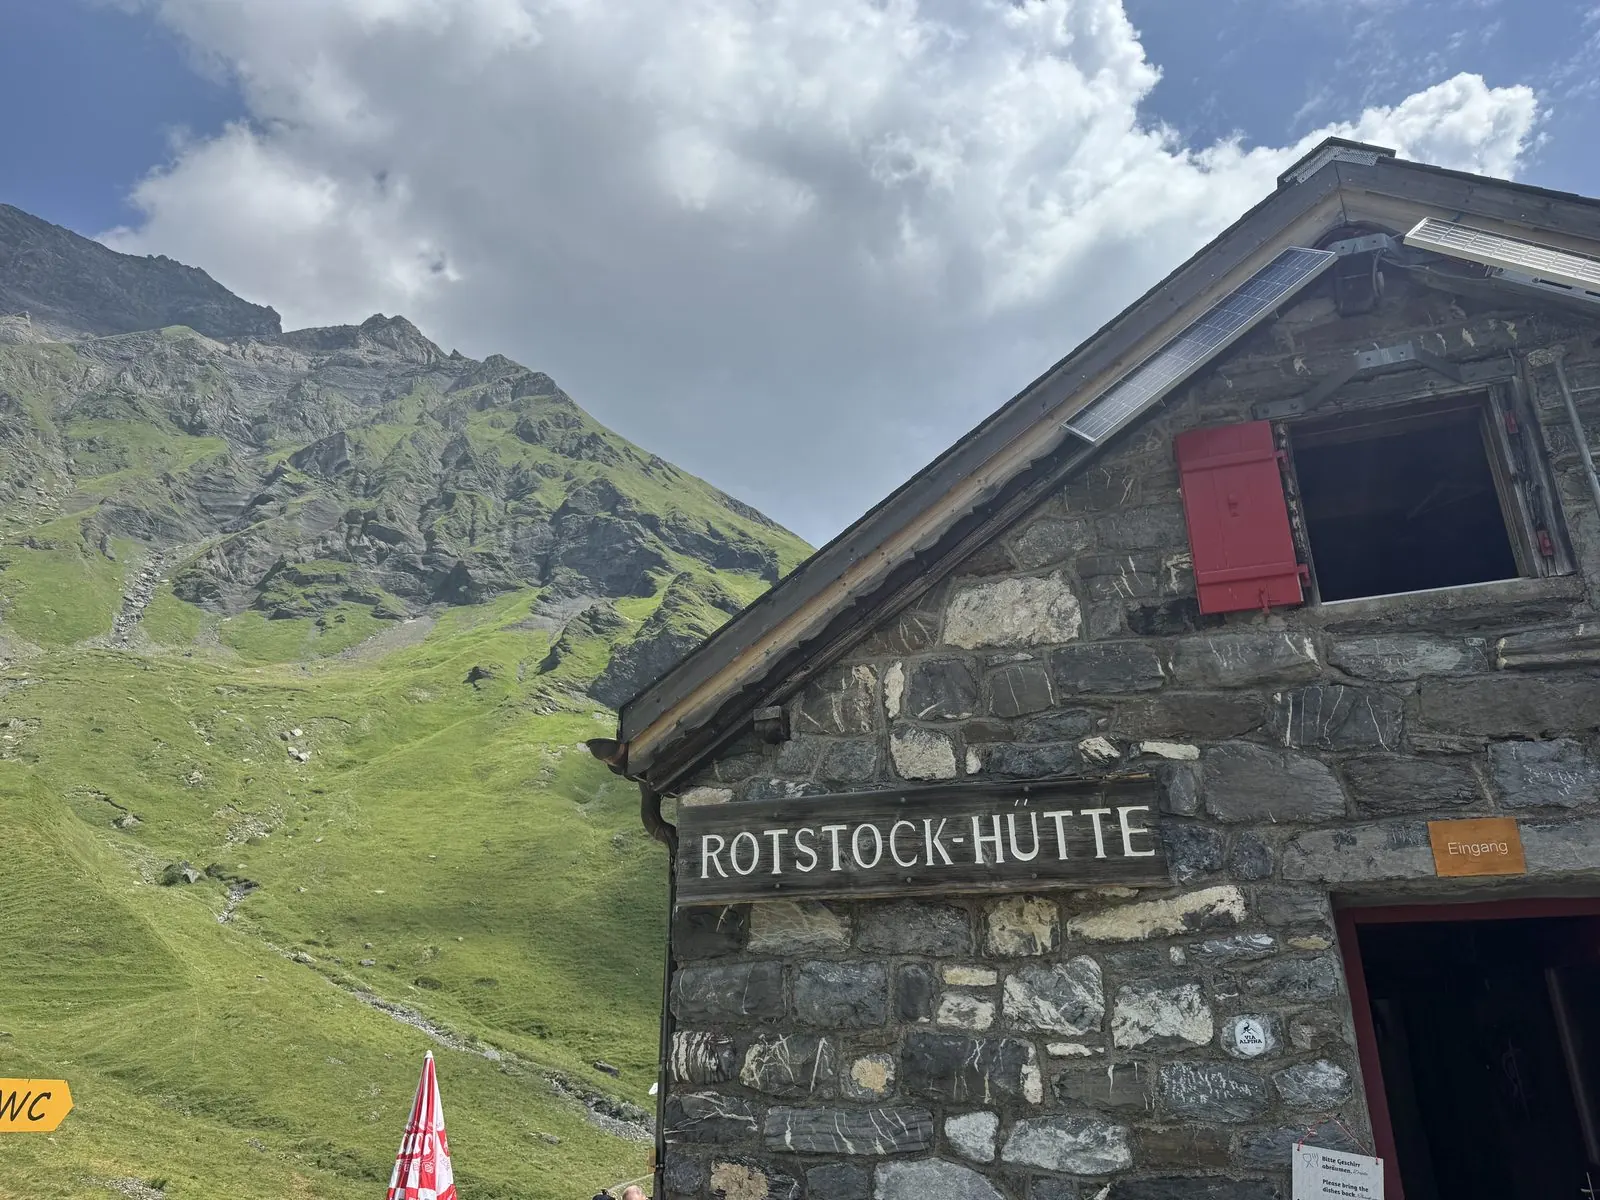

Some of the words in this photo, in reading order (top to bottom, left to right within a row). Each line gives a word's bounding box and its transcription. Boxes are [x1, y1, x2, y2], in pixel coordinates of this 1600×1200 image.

[700, 798, 1156, 879] ROTSTOCK-HÜTTE
[1447, 842, 1508, 857] Eingang
[0, 1090, 52, 1122] WC
[1337, 1158, 1361, 1168] Geschirr
[1322, 1179, 1341, 1188] Please
[1342, 1182, 1358, 1192] bring
[1358, 1185, 1369, 1193] the
[1322, 1187, 1341, 1195] dishes
